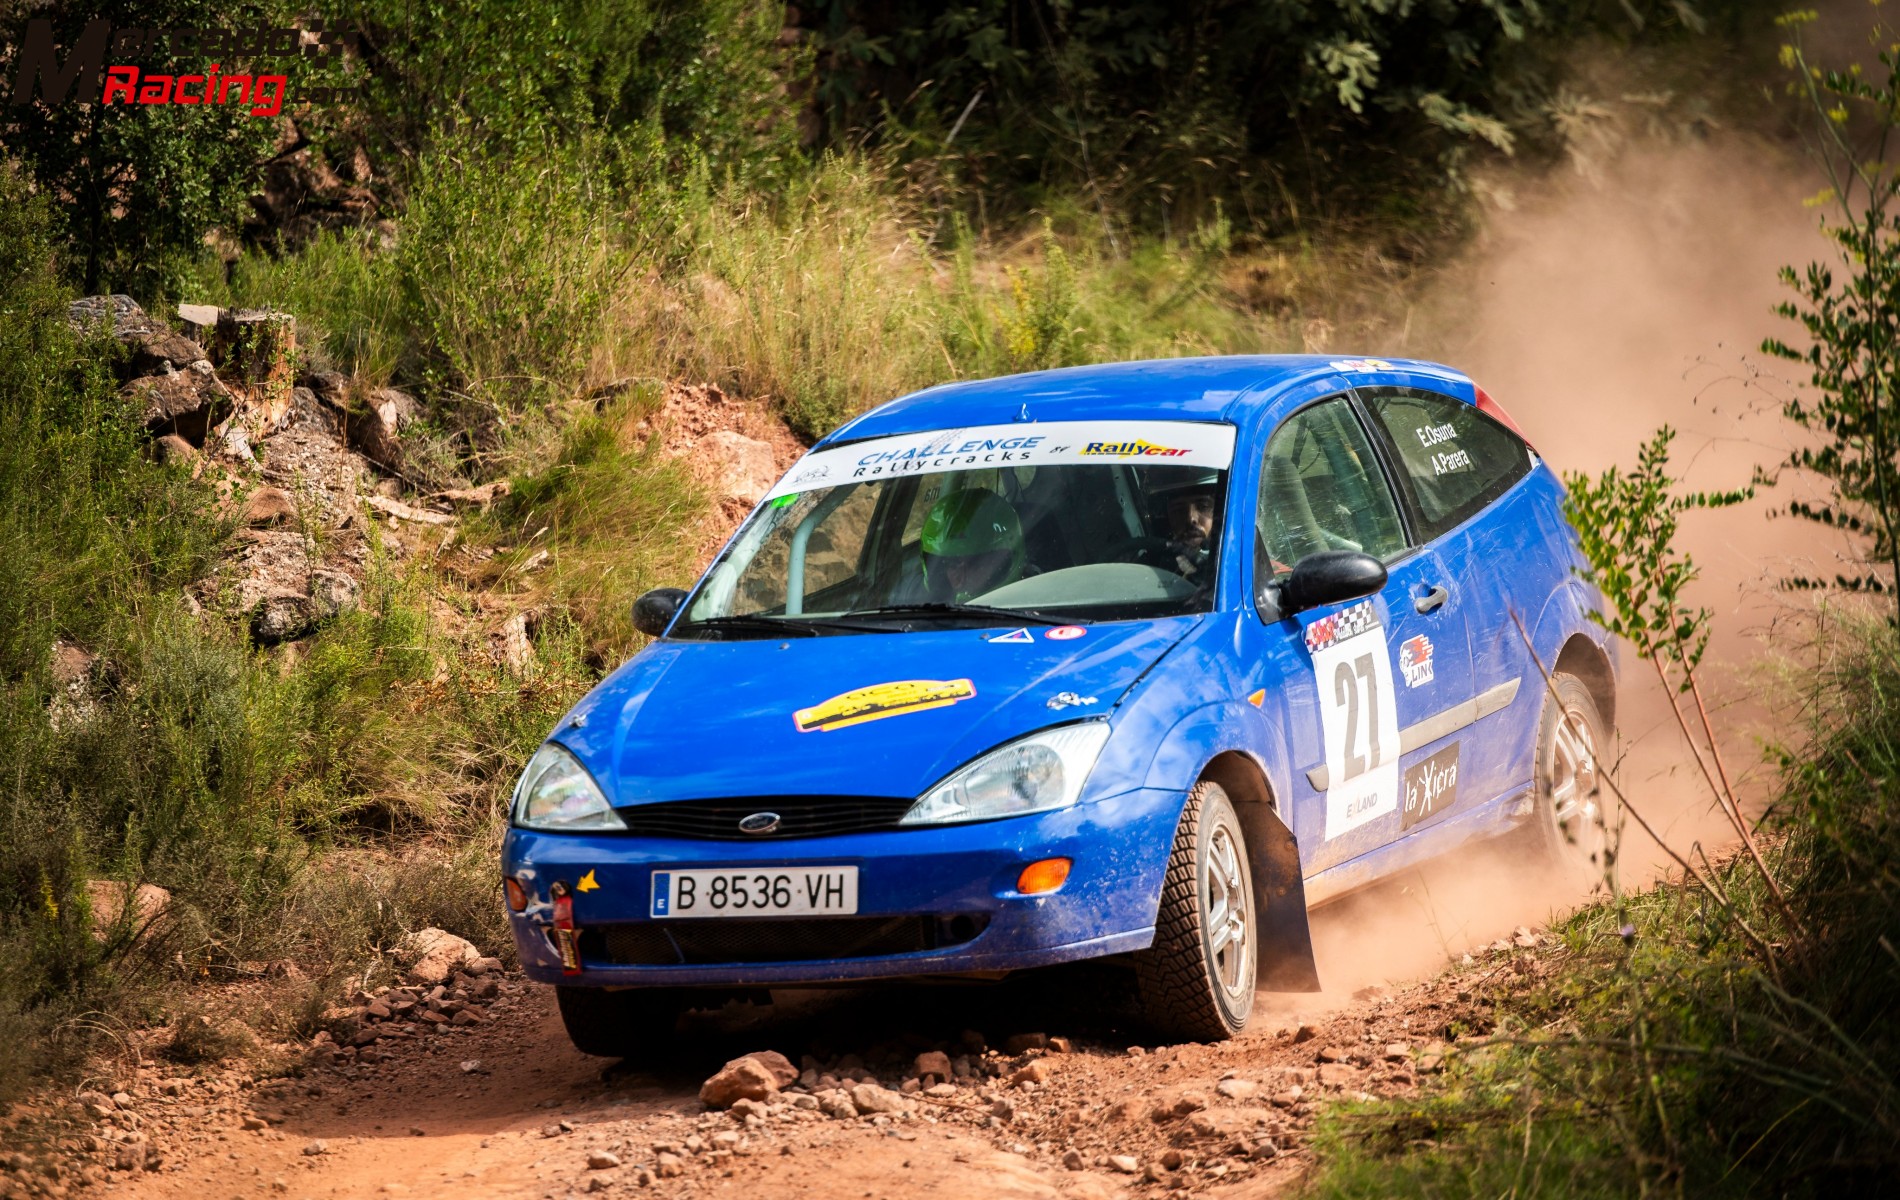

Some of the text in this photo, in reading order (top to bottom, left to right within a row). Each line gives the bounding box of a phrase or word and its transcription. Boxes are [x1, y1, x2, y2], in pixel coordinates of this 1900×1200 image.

[857, 436, 1046, 466] CHALLENGE
[1415, 422, 1457, 448] E.Osuna
[852, 451, 1031, 478] Rallycracks
[1085, 442, 1192, 457] Rallycar
[1431, 449, 1470, 476] A.Parera
[1334, 652, 1381, 783] 27
[677, 876, 696, 910] B
[710, 874, 791, 909] 8536
[805, 873, 844, 909] VH
